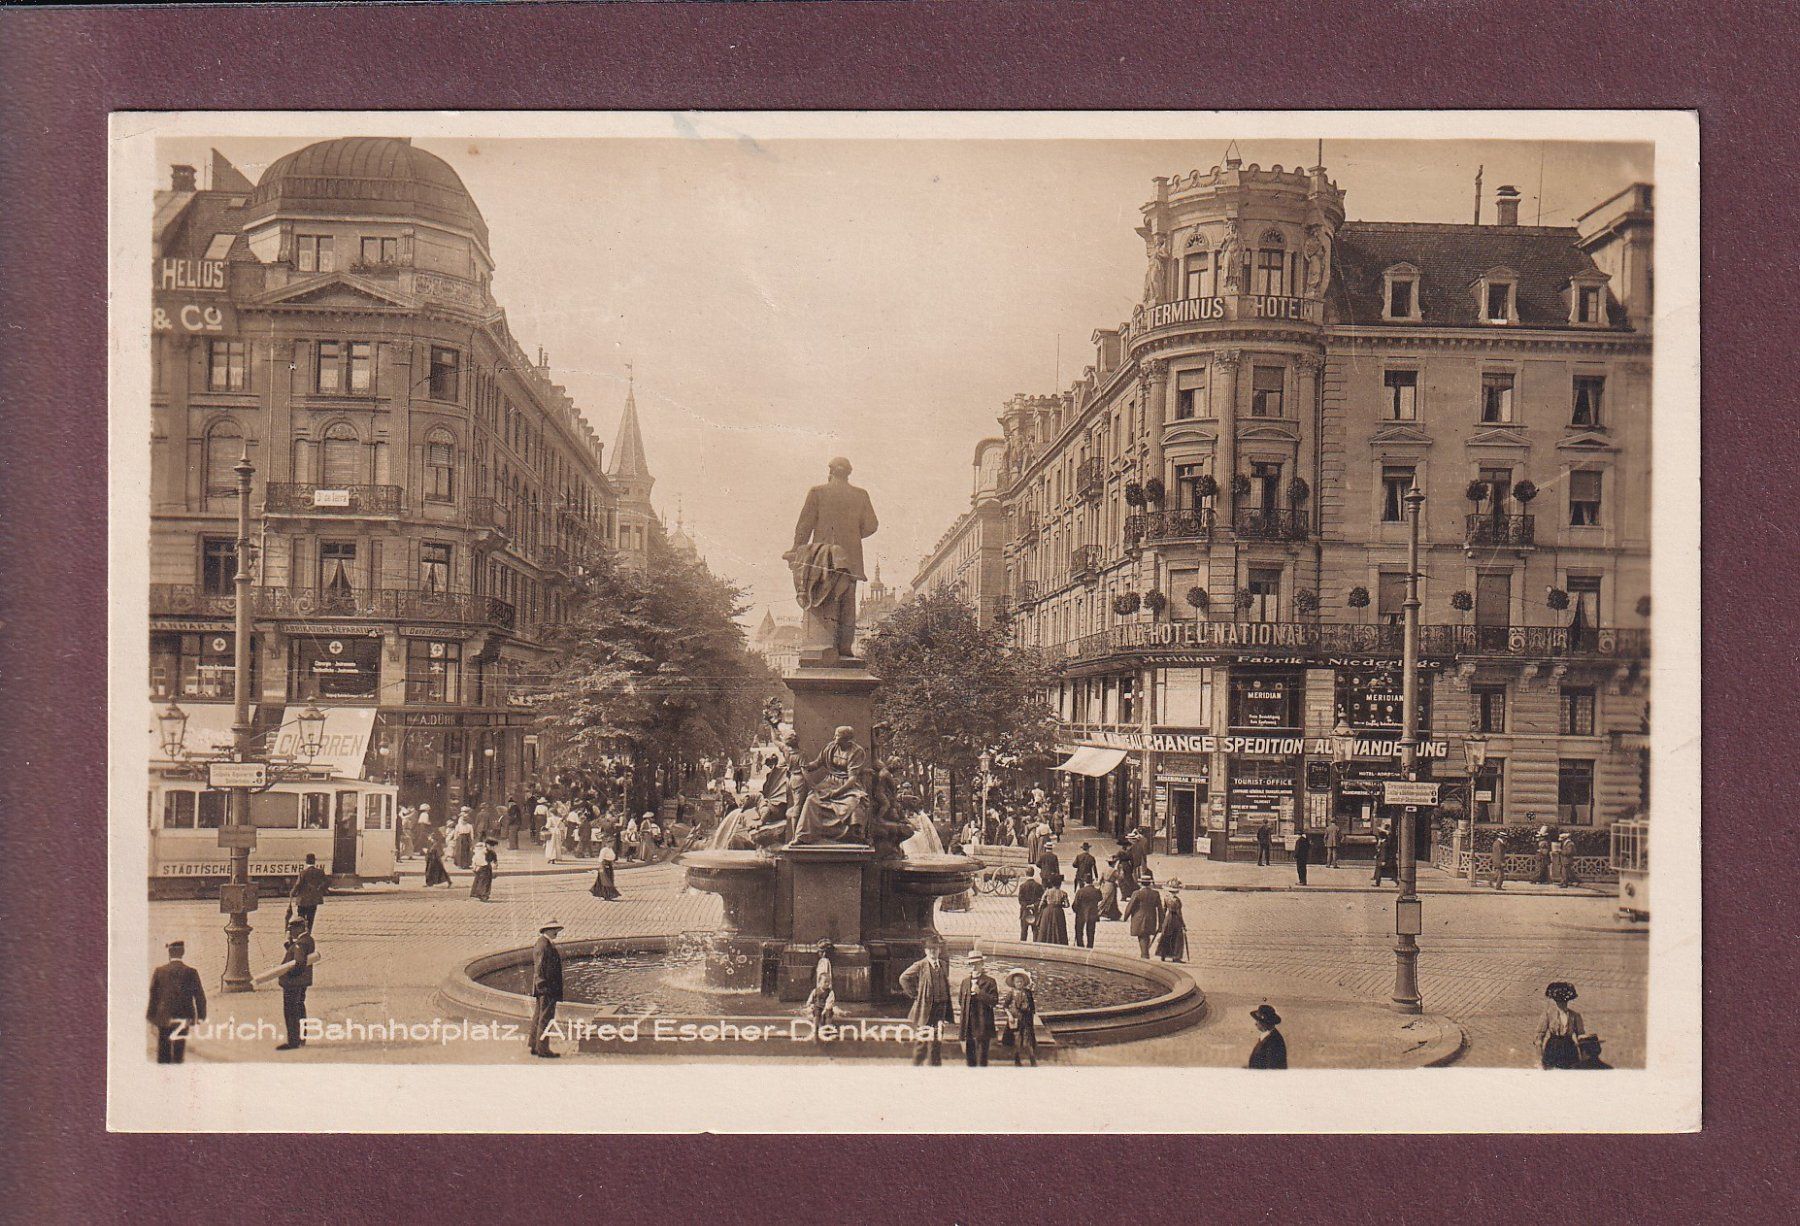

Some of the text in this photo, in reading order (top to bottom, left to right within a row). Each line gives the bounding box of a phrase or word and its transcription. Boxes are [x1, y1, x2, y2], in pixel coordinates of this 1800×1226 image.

[153, 307, 173, 330] &
[1150, 297, 1224, 329] TERMINUS
[1150, 622, 1206, 645] HOTEL
[1213, 623, 1307, 645] NATIONAL
[1328, 658, 1441, 668] Niederlge
[1247, 691, 1282, 699] MERIDIAN
[1366, 694, 1404, 702] MERIDIAN
[279, 733, 364, 756] CIRREN
[1146, 735, 1215, 752] CHANGE
[1224, 737, 1304, 755] SPEDITION
[1314, 739, 1448, 758] AUWANDEUNG
[249, 863, 326, 875] TRASSENBN
